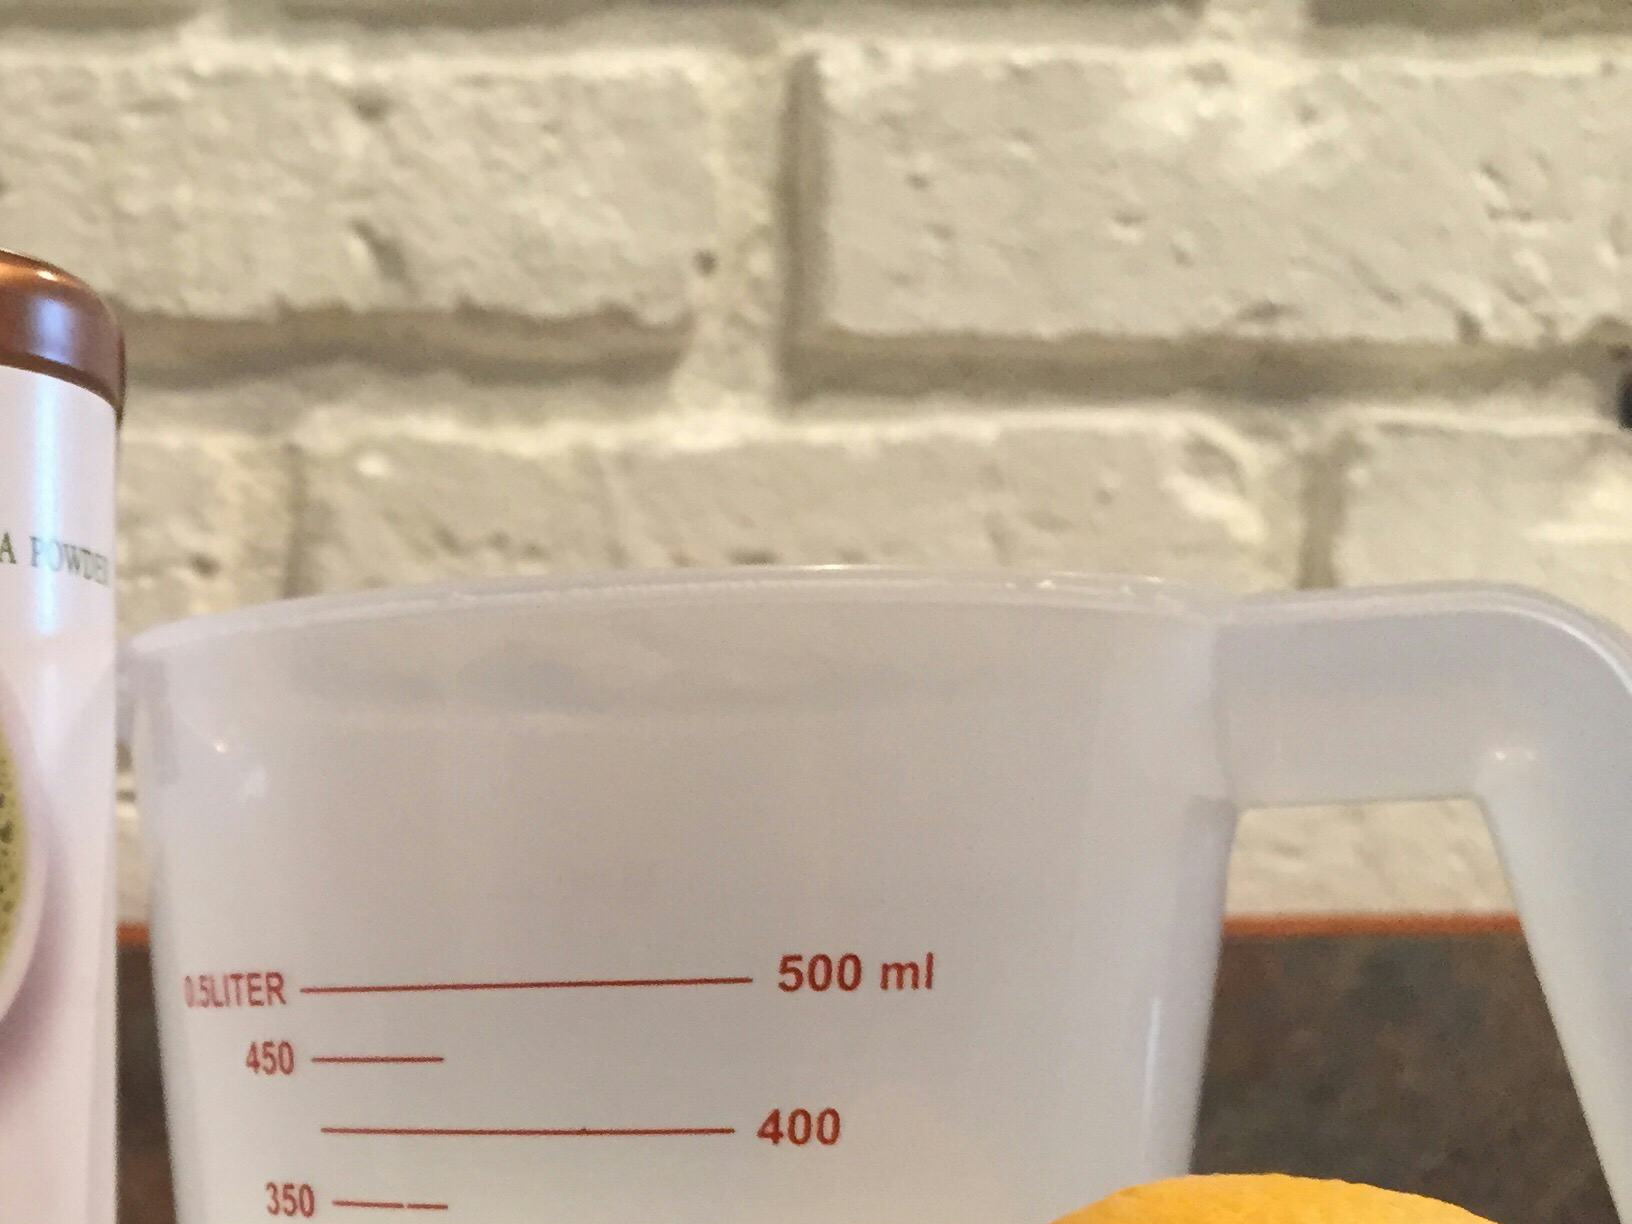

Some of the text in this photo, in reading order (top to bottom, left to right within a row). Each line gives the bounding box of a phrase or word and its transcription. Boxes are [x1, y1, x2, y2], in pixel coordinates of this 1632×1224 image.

[29, 537, 110, 586] POWDE
[776, 953, 935, 993] 500 ml
[245, 1041, 295, 1076] 450
[757, 1108, 842, 1146] 400
[265, 1183, 316, 1218] 350
